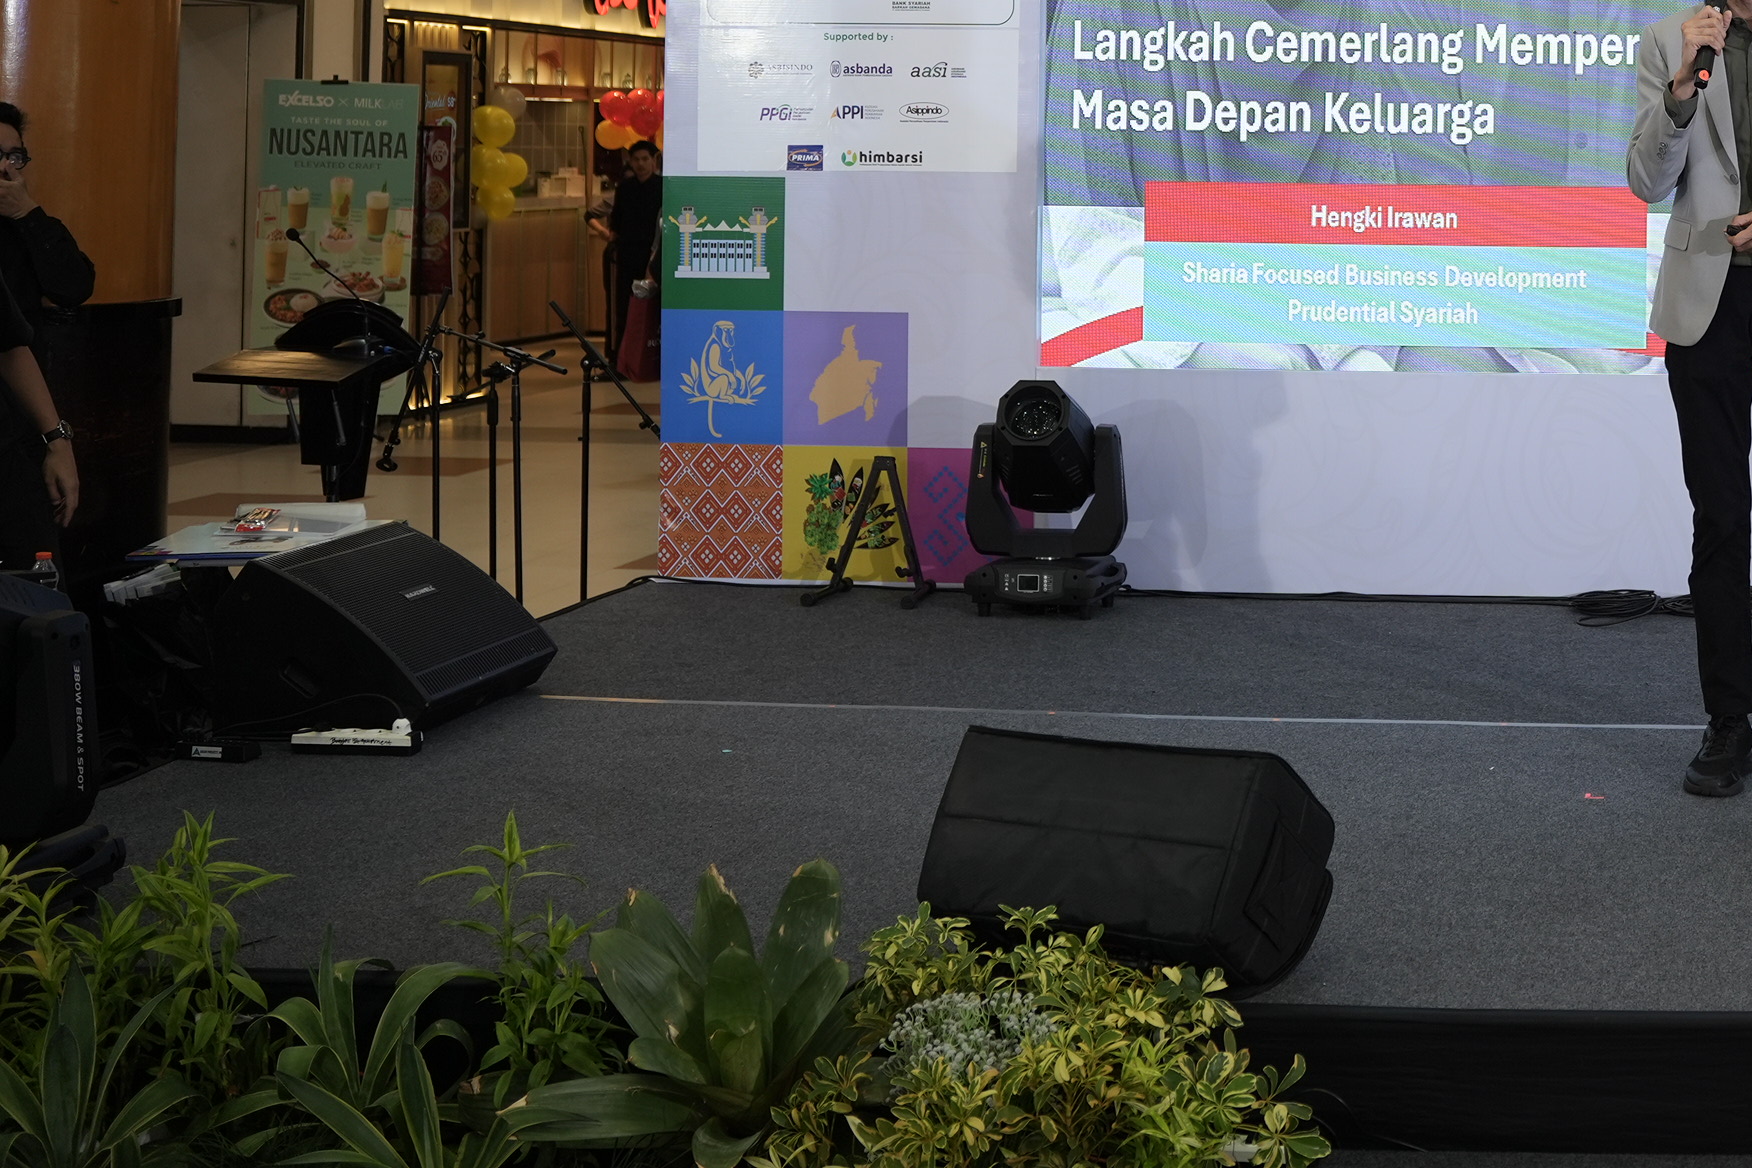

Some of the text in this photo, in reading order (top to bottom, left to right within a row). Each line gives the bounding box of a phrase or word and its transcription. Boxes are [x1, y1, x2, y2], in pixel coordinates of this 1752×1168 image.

[823, 32, 889, 43] Supported by
[1072, 20, 1235, 71] Langkah
[1245, 21, 1464, 75] Cemerlang
[842, 63, 893, 74] asbanda
[910, 61, 948, 78] aasi
[278, 90, 334, 107] EXCELSO
[906, 105, 942, 116] Asippindo
[1072, 90, 1495, 146] Masa Depan Keluarga
[291, 117, 320, 125] TASTE
[346, 118, 370, 127] SOUL
[375, 119, 388, 127] OF
[268, 127, 408, 160] NUSANTARA
[792, 154, 820, 162] PRIMA
[859, 150, 923, 163] himbarsi
[294, 160, 382, 171] ELEVATED CRAFT
[1311, 205, 1458, 233] Hengki Irawan
[1182, 262, 1587, 294] Sharia Focused Business Development
[1288, 299, 1478, 327] Prudential Syariah
[75, 707, 83, 744] BEAM
[76, 746, 84, 754] &
[76, 757, 85, 792] SPOT
